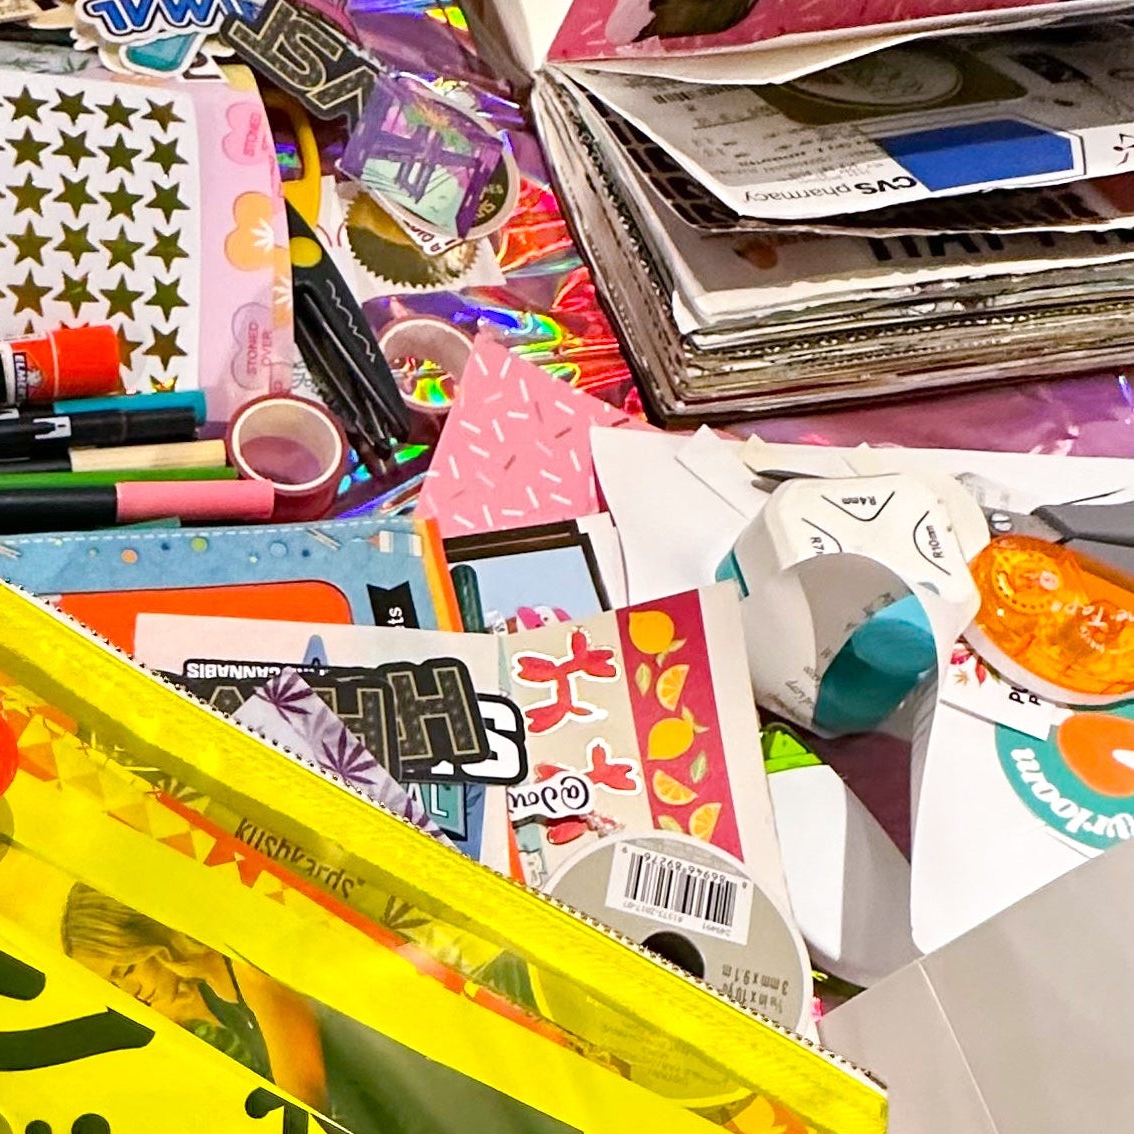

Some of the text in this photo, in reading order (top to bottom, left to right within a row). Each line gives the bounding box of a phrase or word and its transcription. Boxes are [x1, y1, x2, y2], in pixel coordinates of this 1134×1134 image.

[742, 175, 917, 203] CVS pharmacy
[246, 320, 259, 376] STONED
[261, 330, 273, 366] OVER
